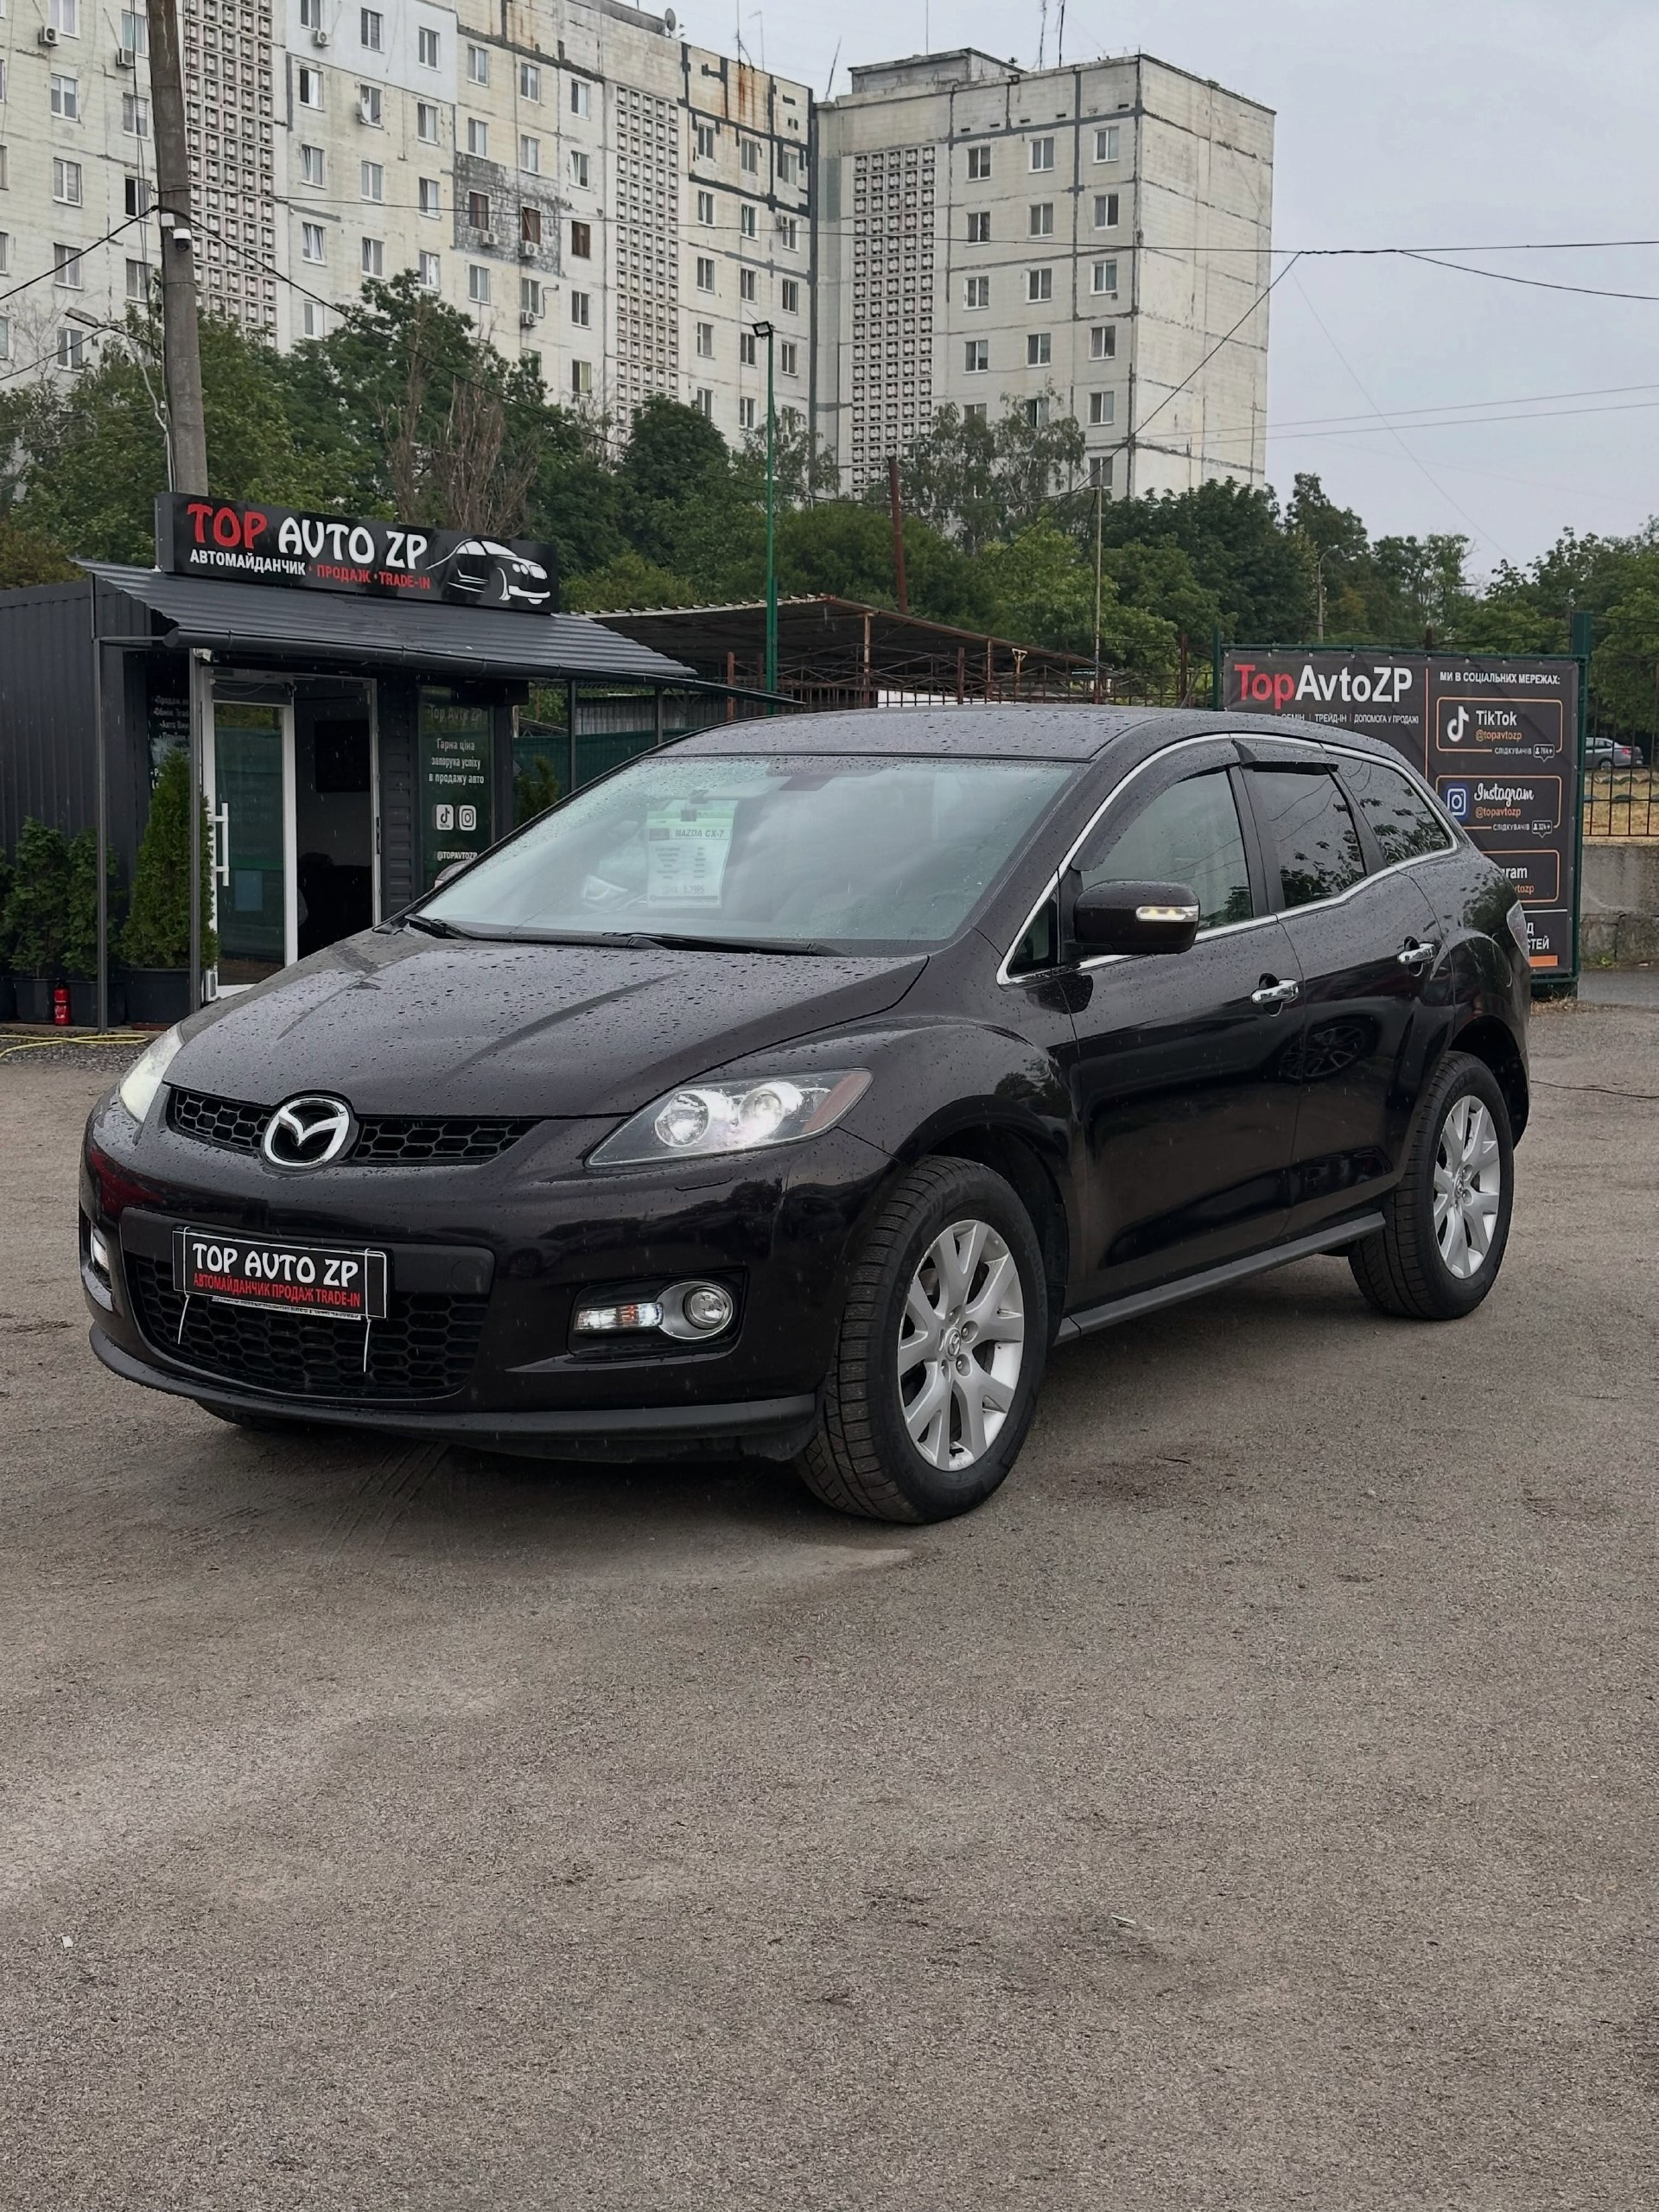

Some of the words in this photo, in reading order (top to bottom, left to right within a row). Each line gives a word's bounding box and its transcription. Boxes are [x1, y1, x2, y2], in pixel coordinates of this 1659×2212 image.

[187, 503, 267, 550] TOP
[385, 531, 429, 570] ZP
[189, 548, 306, 575] АВТОМАЙДАНЧИК
[316, 564, 371, 584] ПРОДАЖ
[379, 573, 431, 590] TRADE-IN
[1440, 671, 1453, 682] МИ
[1455, 672, 1461, 681] В
[1462, 672, 1517, 684] СОЦІАЛЬНИХ
[1518, 673, 1560, 685] МЕРЕЖАХ:
[1233, 664, 1413, 709] TopAvtoZP
[1354, 714, 1387, 724] ДОПОМОГА
[1476, 710, 1517, 727] TikTok
[1475, 730, 1522, 742] @topavtozp
[436, 738, 458, 752] Гарна
[460, 740, 475, 752] ціна
[431, 756, 461, 769] запорука
[435, 773, 467, 785] продажу
[468, 775, 485, 784] авто
[1474, 783, 1534, 807] Instagram
[1475, 807, 1522, 819] @topavtozp
[675, 829, 702, 837] MAZDA
[704, 829, 725, 837] CX-7
[437, 851, 478, 861] @TOPAVTOZP
[192, 1243, 238, 1274] TOP
[323, 1258, 359, 1288] ZP
[193, 1272, 270, 1296] АВТОМАЙДАНЧИК
[272, 1284, 315, 1303] ПРОДАЖ
[315, 1288, 360, 1308] TRADE-IN
